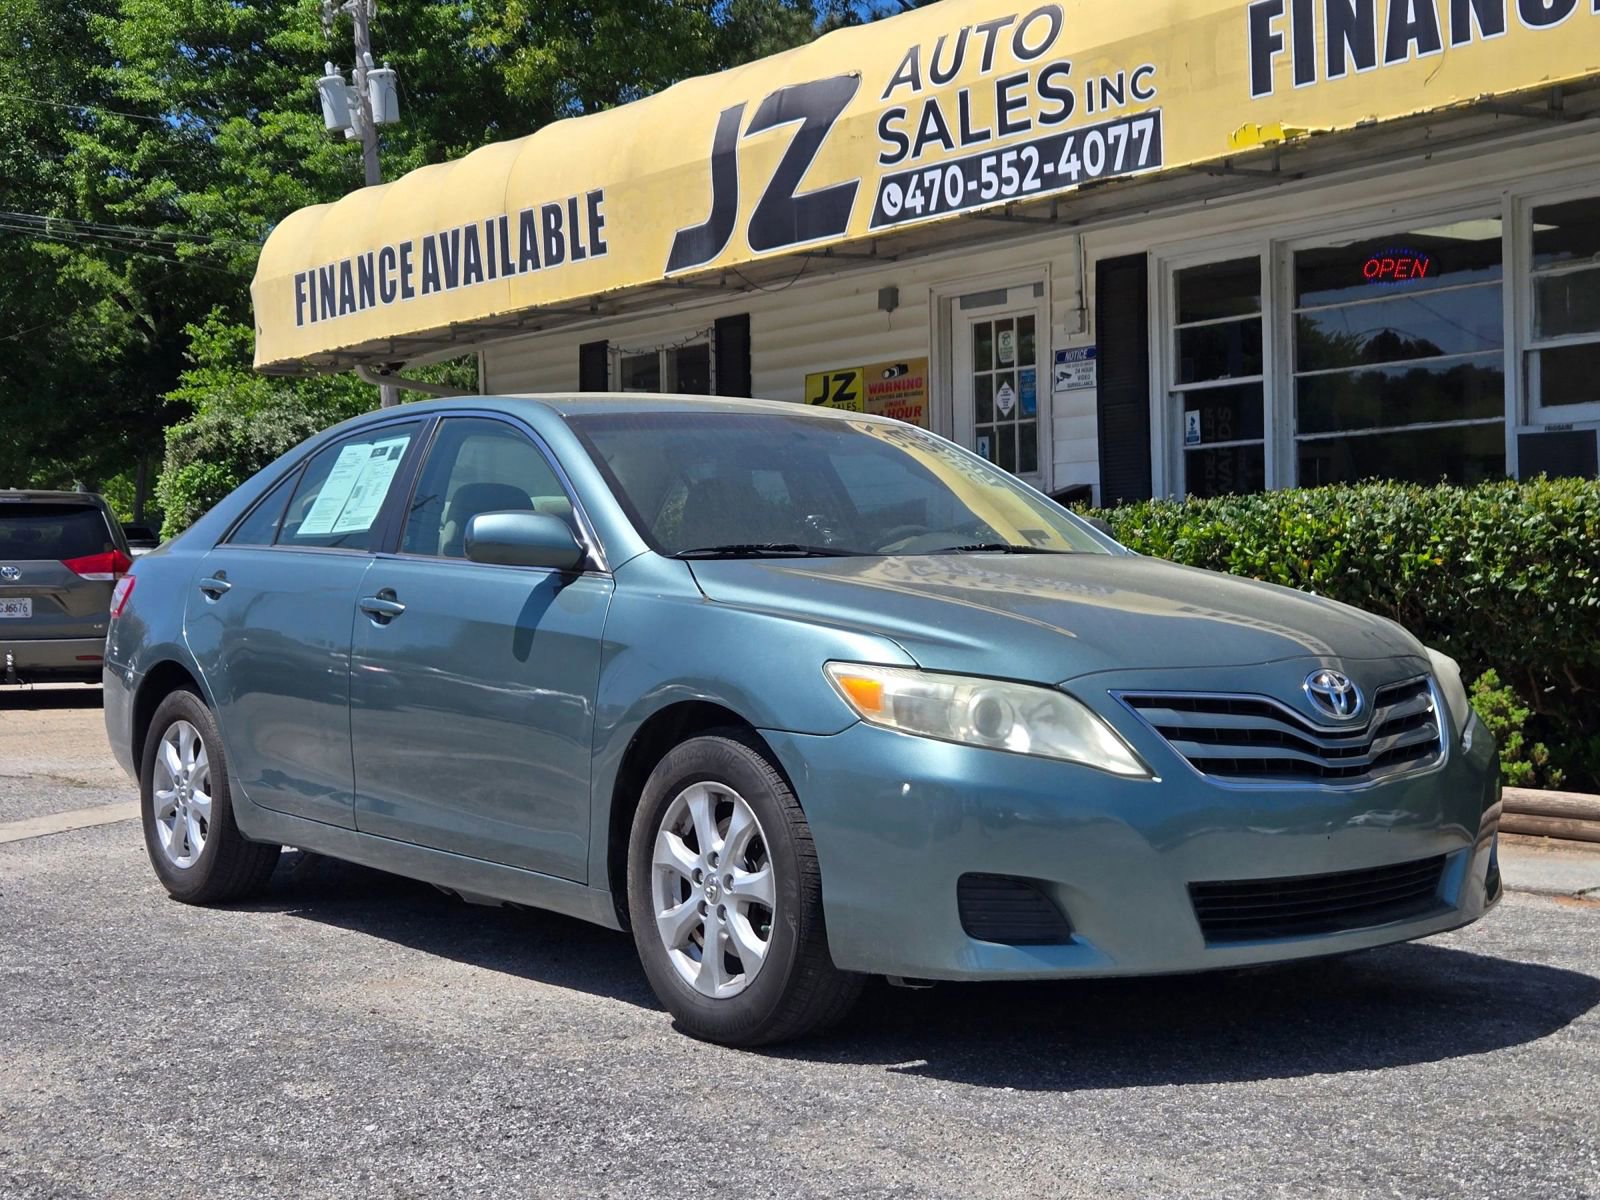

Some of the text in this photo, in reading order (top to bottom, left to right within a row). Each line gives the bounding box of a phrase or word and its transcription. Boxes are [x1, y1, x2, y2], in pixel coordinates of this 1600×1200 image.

[881, 4, 1063, 100] AUTO
[876, 61, 1157, 166] SALES INC
[665, 72, 861, 273] JZ
[903, 118, 1155, 214] 470-552-4077
[295, 190, 607, 327] FINANCE AVAILABLE
[1362, 257, 1430, 280] OPEN
[869, 377, 922, 394] WARNING
[1065, 348, 1088, 361] NOTICE
[812, 371, 857, 405] JZ
[888, 405, 922, 419] HOUR
